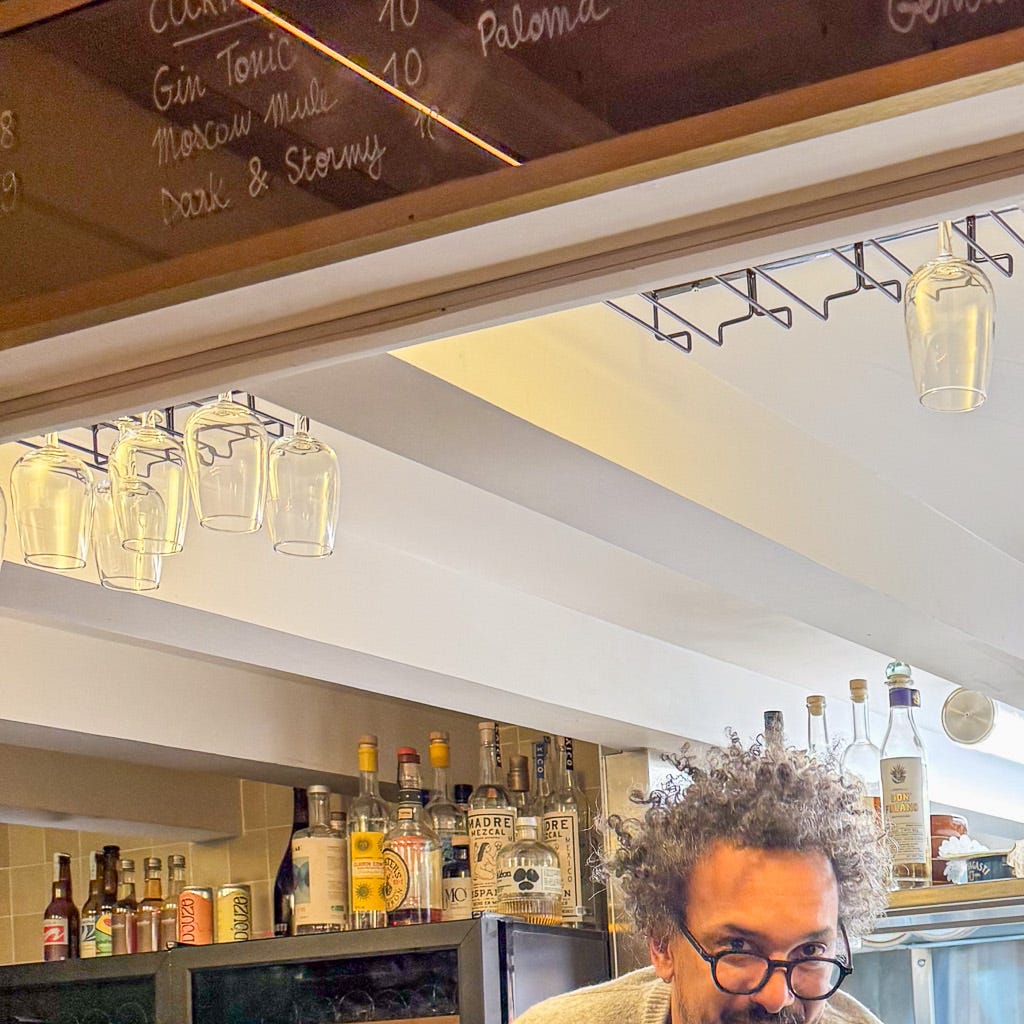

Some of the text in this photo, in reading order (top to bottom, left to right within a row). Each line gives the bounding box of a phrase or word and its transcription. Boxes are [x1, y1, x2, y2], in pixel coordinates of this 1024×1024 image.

[477, 0, 611, 57] Paloma
[151, 47, 422, 167] Moscow Mule 10
[153, 65, 206, 111] Gin
[216, 32, 297, 87] Tonic
[160, 171, 231, 226] Dark
[248, 155, 270, 198] &
[284, 133, 388, 182] Stormy
[545, 819, 569, 831] DRE
